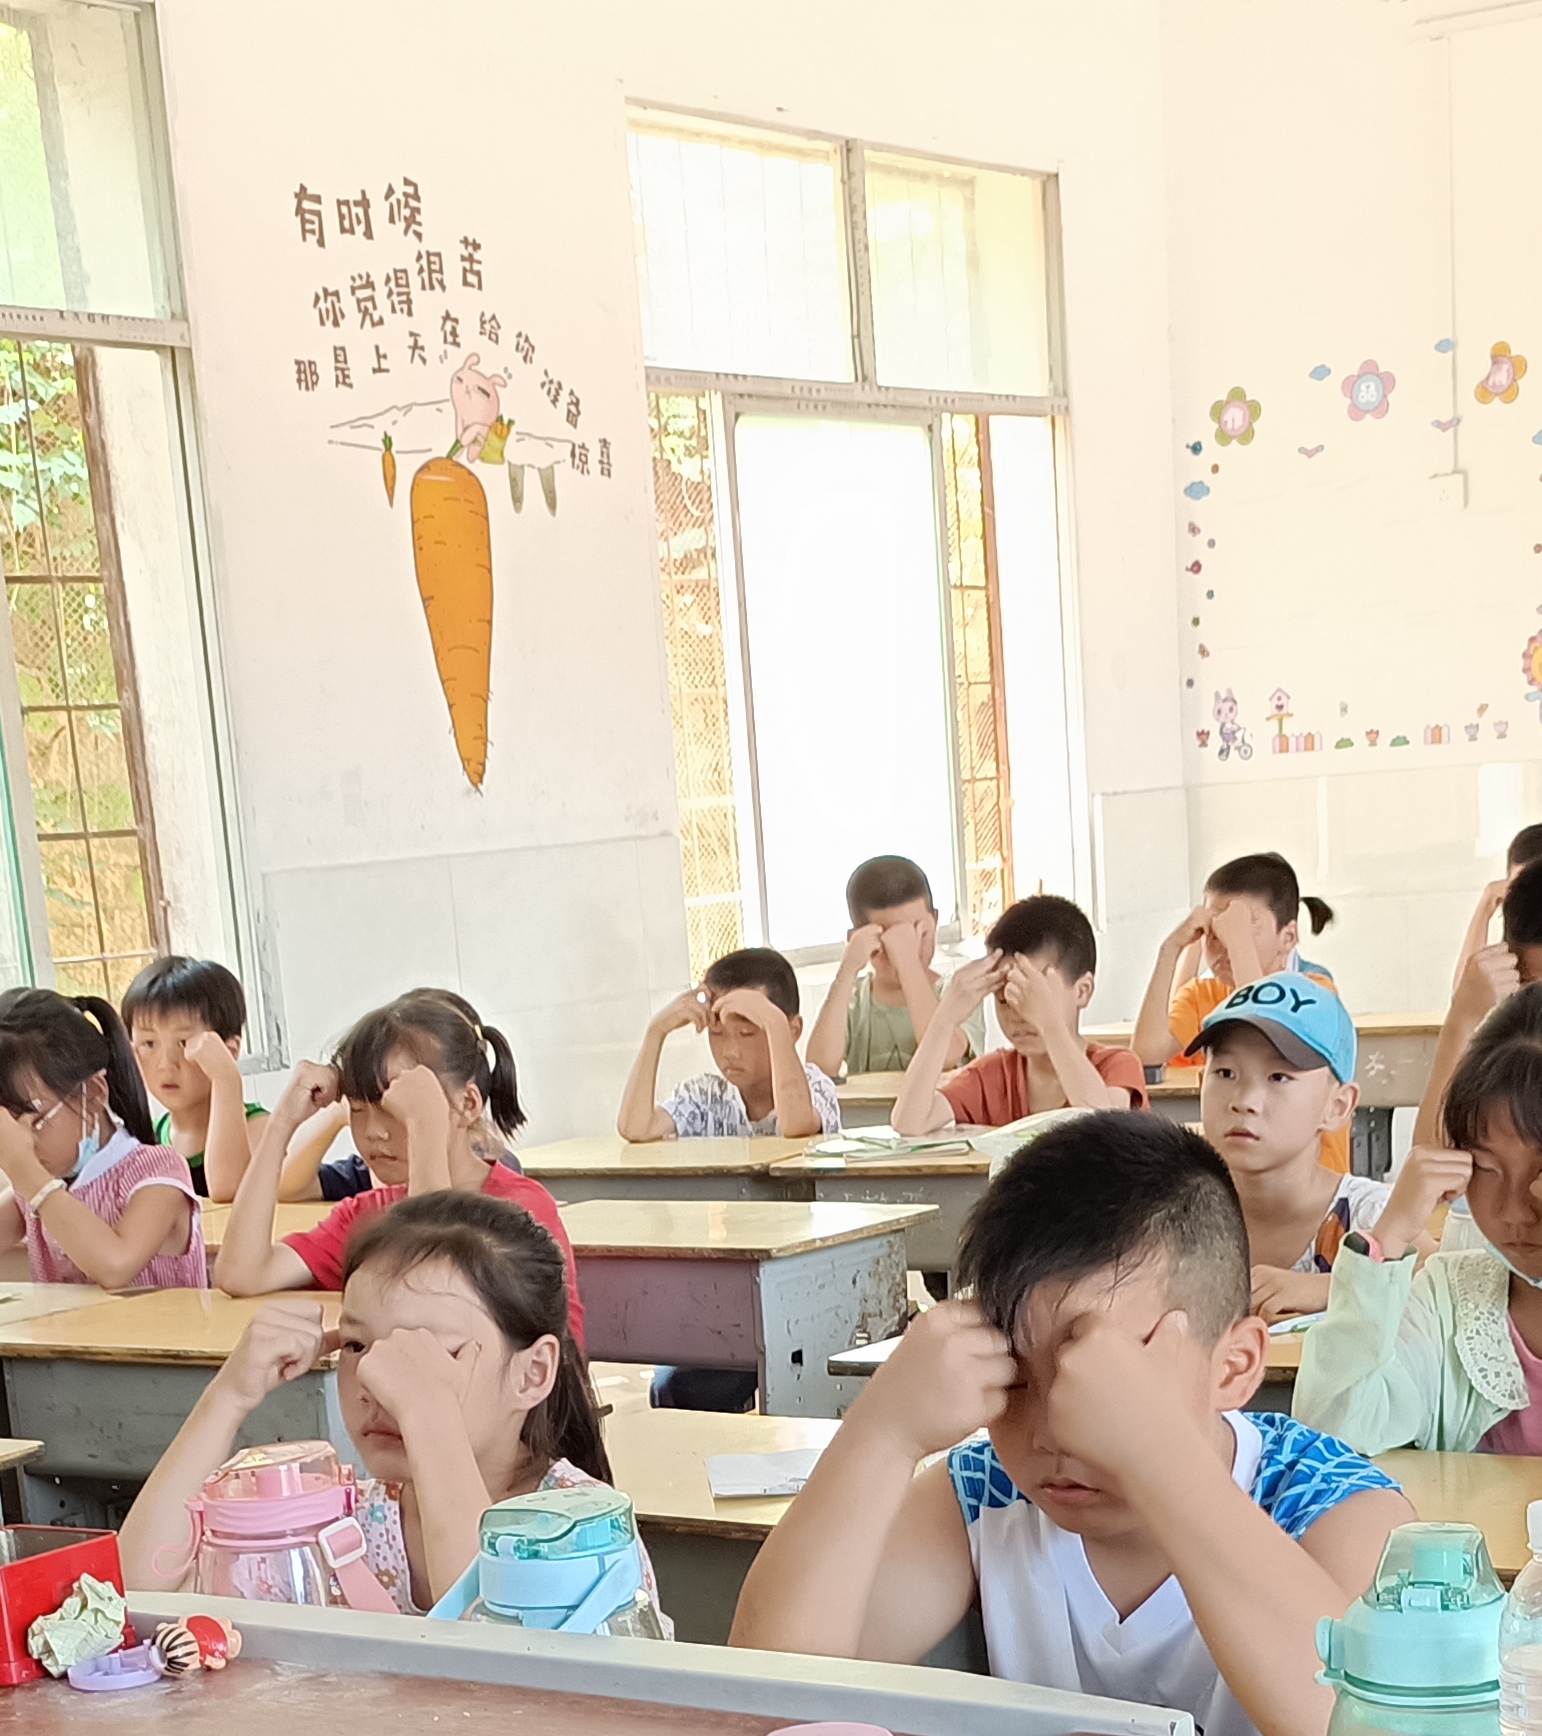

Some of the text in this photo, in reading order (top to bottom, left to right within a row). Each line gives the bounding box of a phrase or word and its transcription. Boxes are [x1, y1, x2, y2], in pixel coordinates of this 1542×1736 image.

[293, 176, 423, 249] 有时候
[312, 236, 484, 330] 你觉得很苦
[1225, 981, 1317, 1013] BOY
